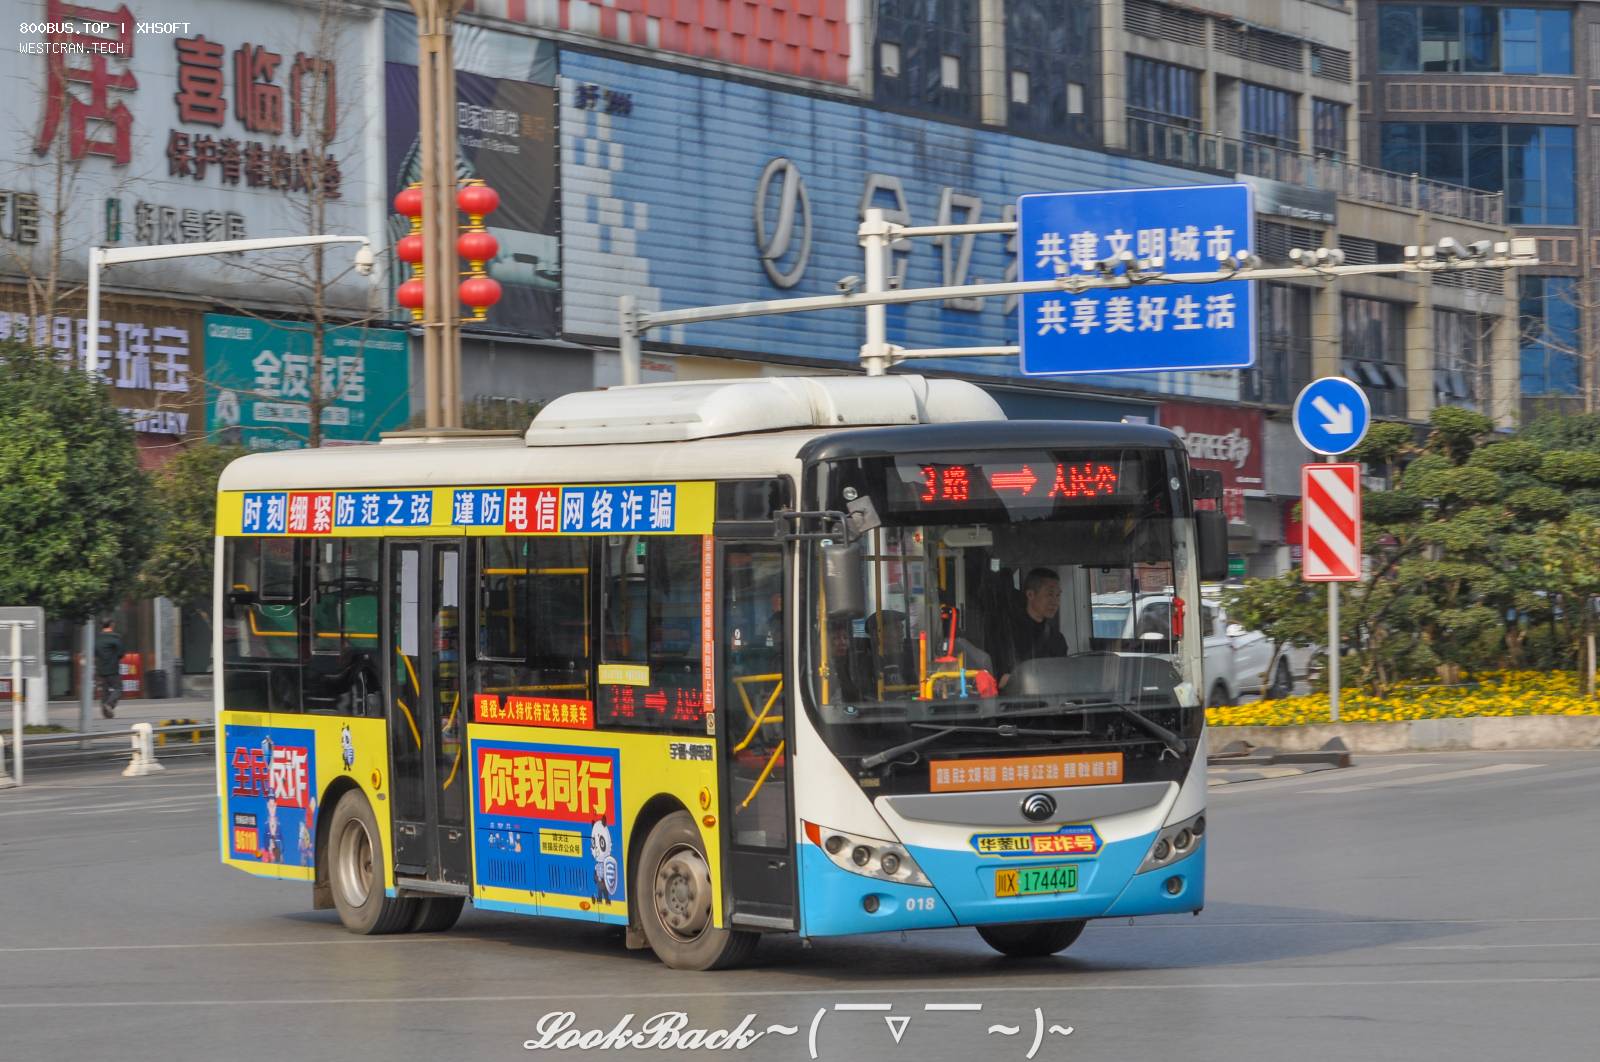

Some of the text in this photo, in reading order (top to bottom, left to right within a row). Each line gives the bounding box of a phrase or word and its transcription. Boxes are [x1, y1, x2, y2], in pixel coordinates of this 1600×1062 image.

[174, 34, 337, 142] 喜临门
[1035, 225, 1236, 268] 共建文明城市
[1036, 293, 1237, 336] 共享美好生活
[243, 488, 673, 531] 时刻绷紧防范之弦 谨防电信网络诈骗
[480, 753, 613, 816] 你我同行
[1023, 867, 1077, 892] 17444D
[905, 897, 936, 912] 018
